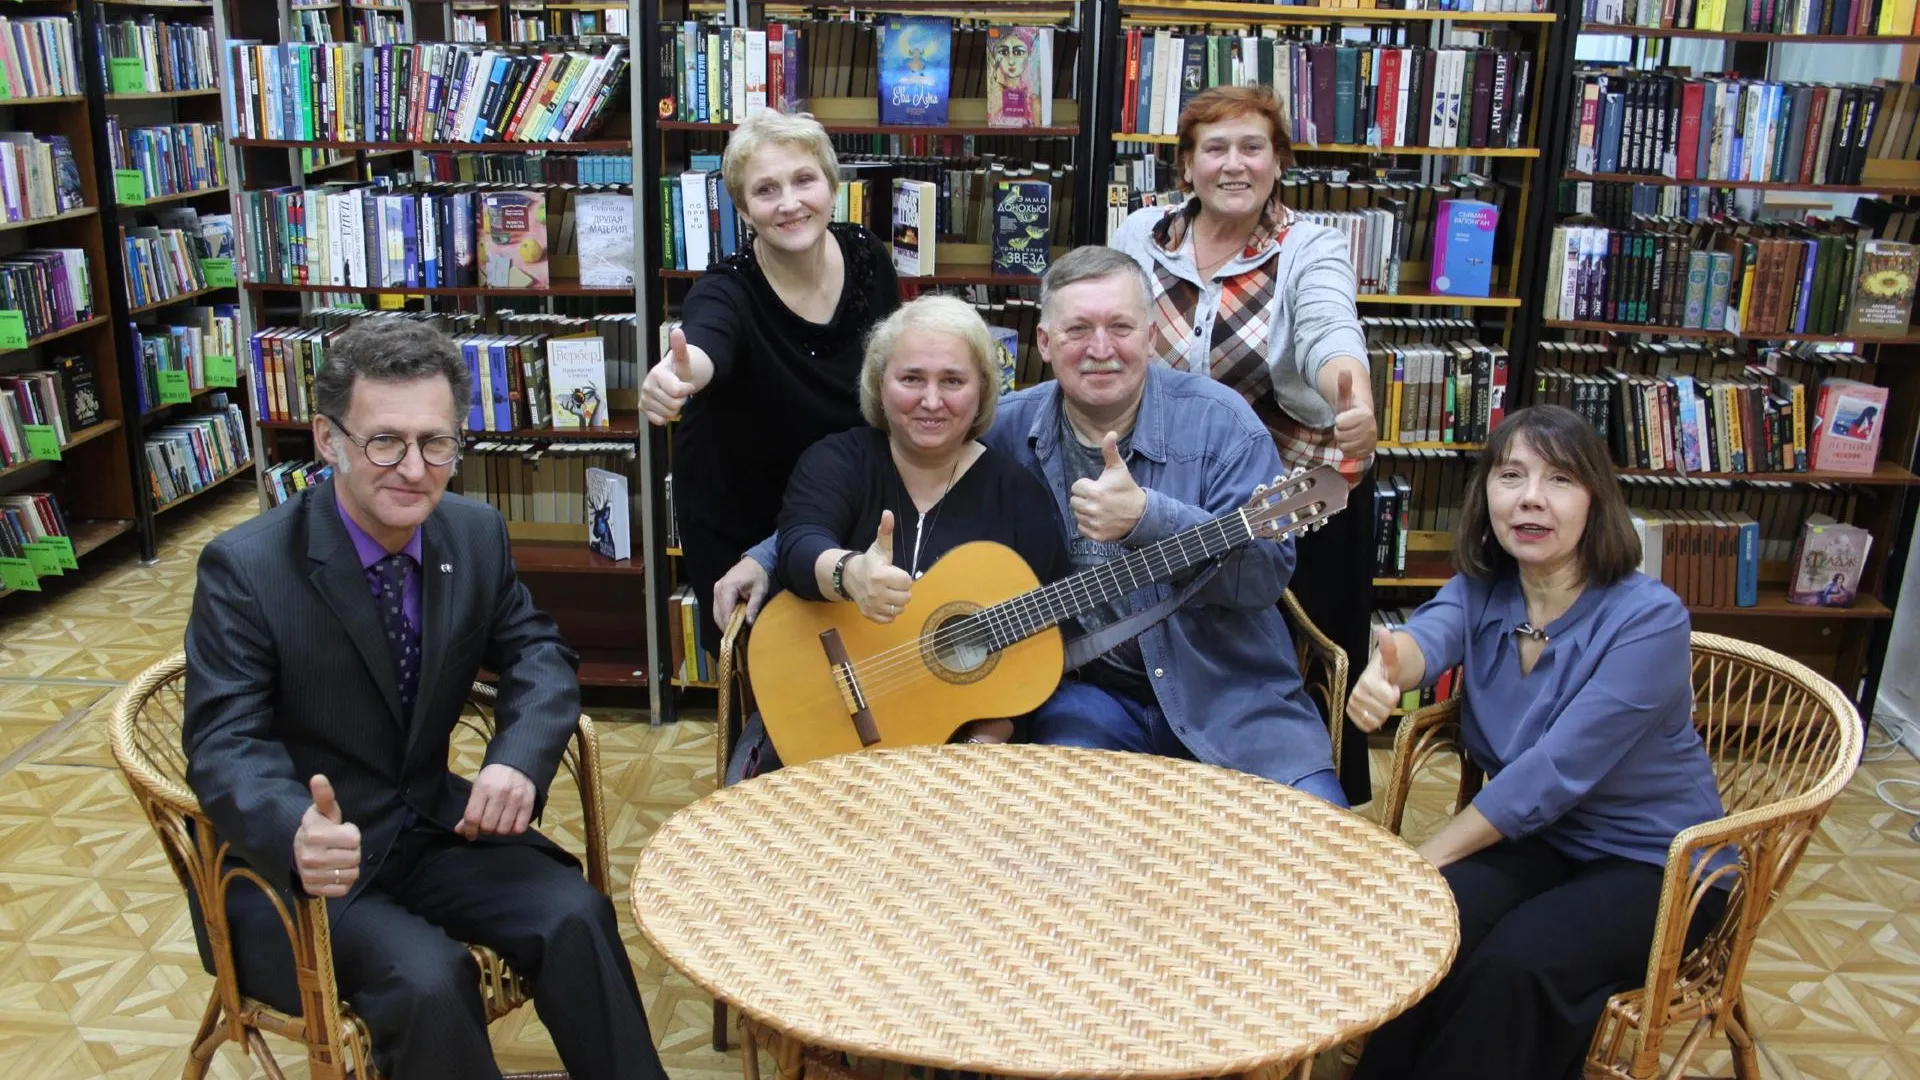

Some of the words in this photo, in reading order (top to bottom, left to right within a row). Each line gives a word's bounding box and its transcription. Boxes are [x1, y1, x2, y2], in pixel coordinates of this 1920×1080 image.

[1491, 104, 1501, 133] ЛАРС
[1496, 55, 1507, 105] КЕПЛЕР
[997, 203, 1047, 214] ДОНОХЬЮ
[593, 214, 624, 225] ДРУГАЯ
[588, 224, 628, 234] МАТЕРИЯ
[1007, 252, 1046, 266] ЗВЕЗД
[556, 350, 598, 364] Вербер
[1538, 379, 1546, 392] 1
[1550, 380, 1558, 392] 2
